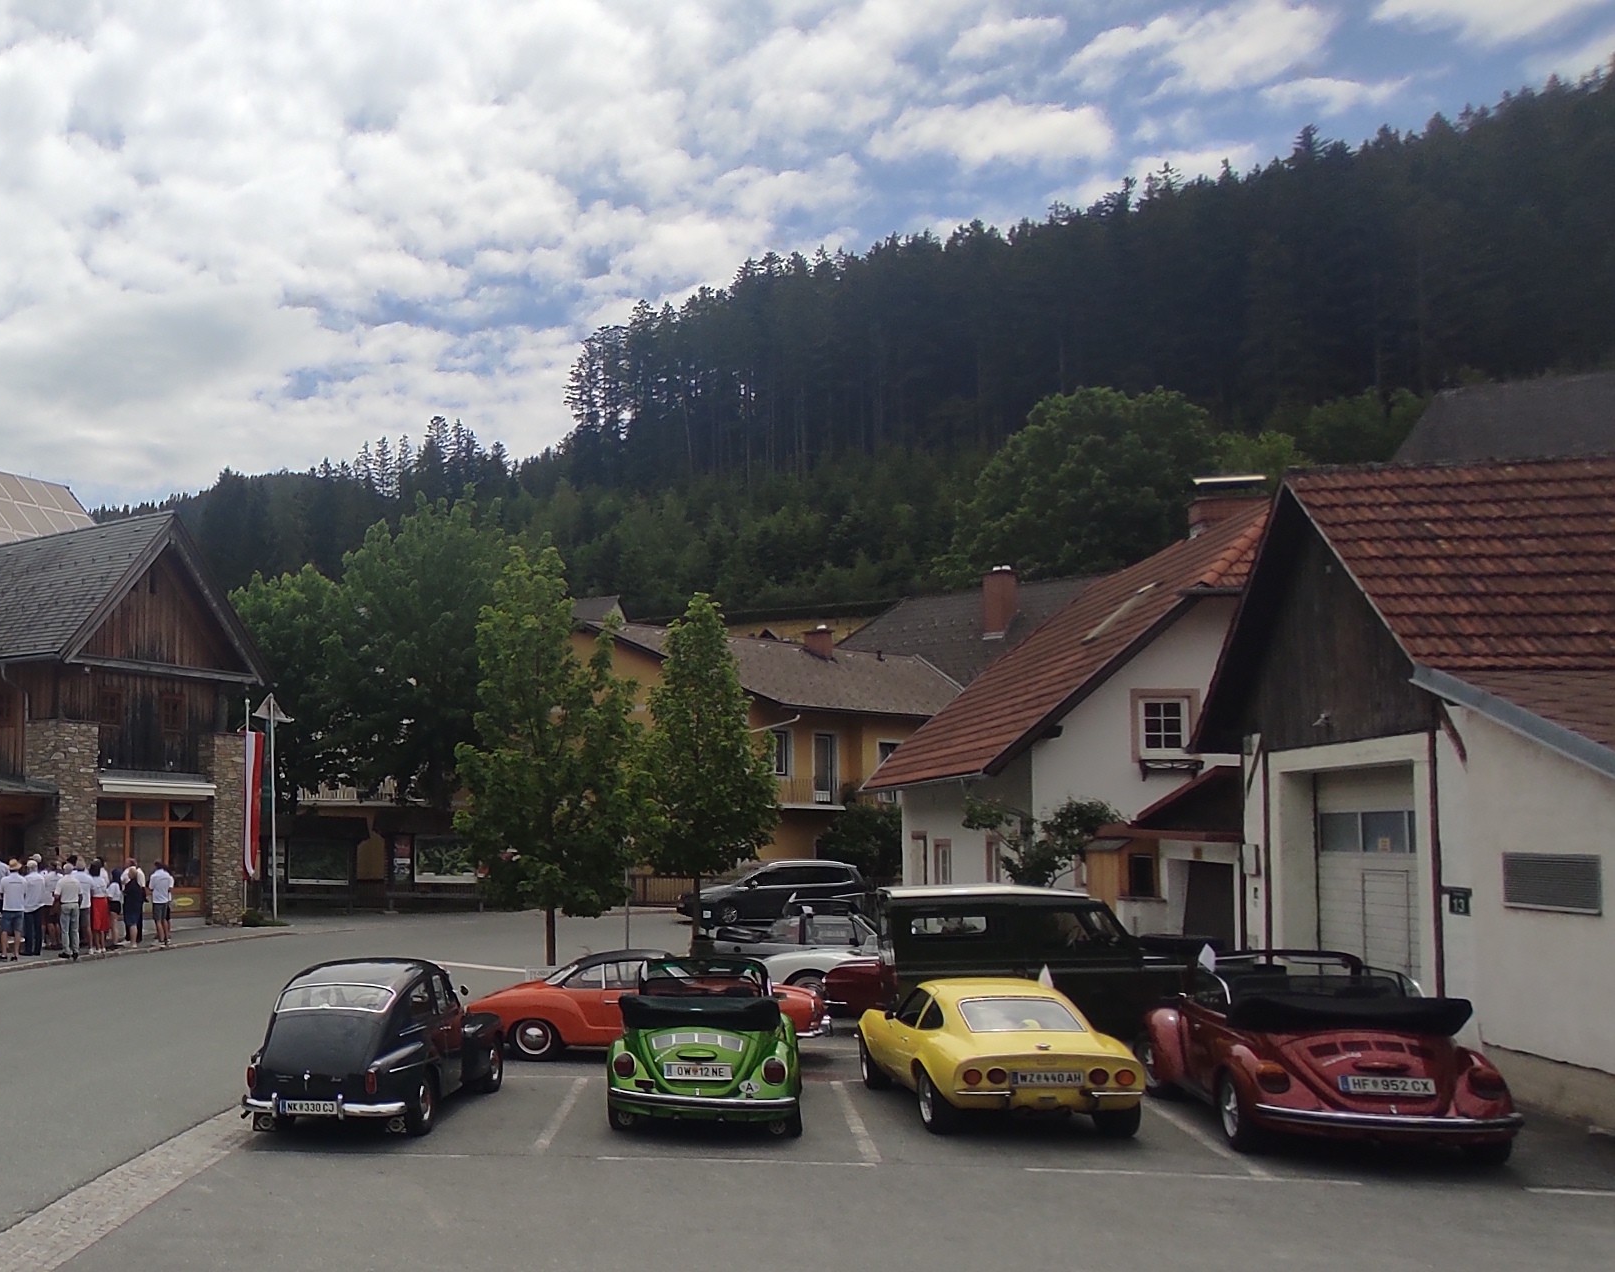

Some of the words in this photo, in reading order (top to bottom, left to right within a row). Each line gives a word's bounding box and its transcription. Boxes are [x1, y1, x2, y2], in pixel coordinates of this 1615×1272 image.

[1453, 899, 1465, 912] 13
[700, 1067, 709, 1076] 12
[712, 1067, 724, 1076] NE
[1020, 1073, 1034, 1083] WZ
[746, 1082, 754, 1092] A
[1353, 1078, 1370, 1090] HF
[1382, 1079, 1408, 1091] 952
[1411, 1080, 1431, 1093] CX
[287, 1102, 298, 1112] NK
[304, 1103, 321, 1112] 330
